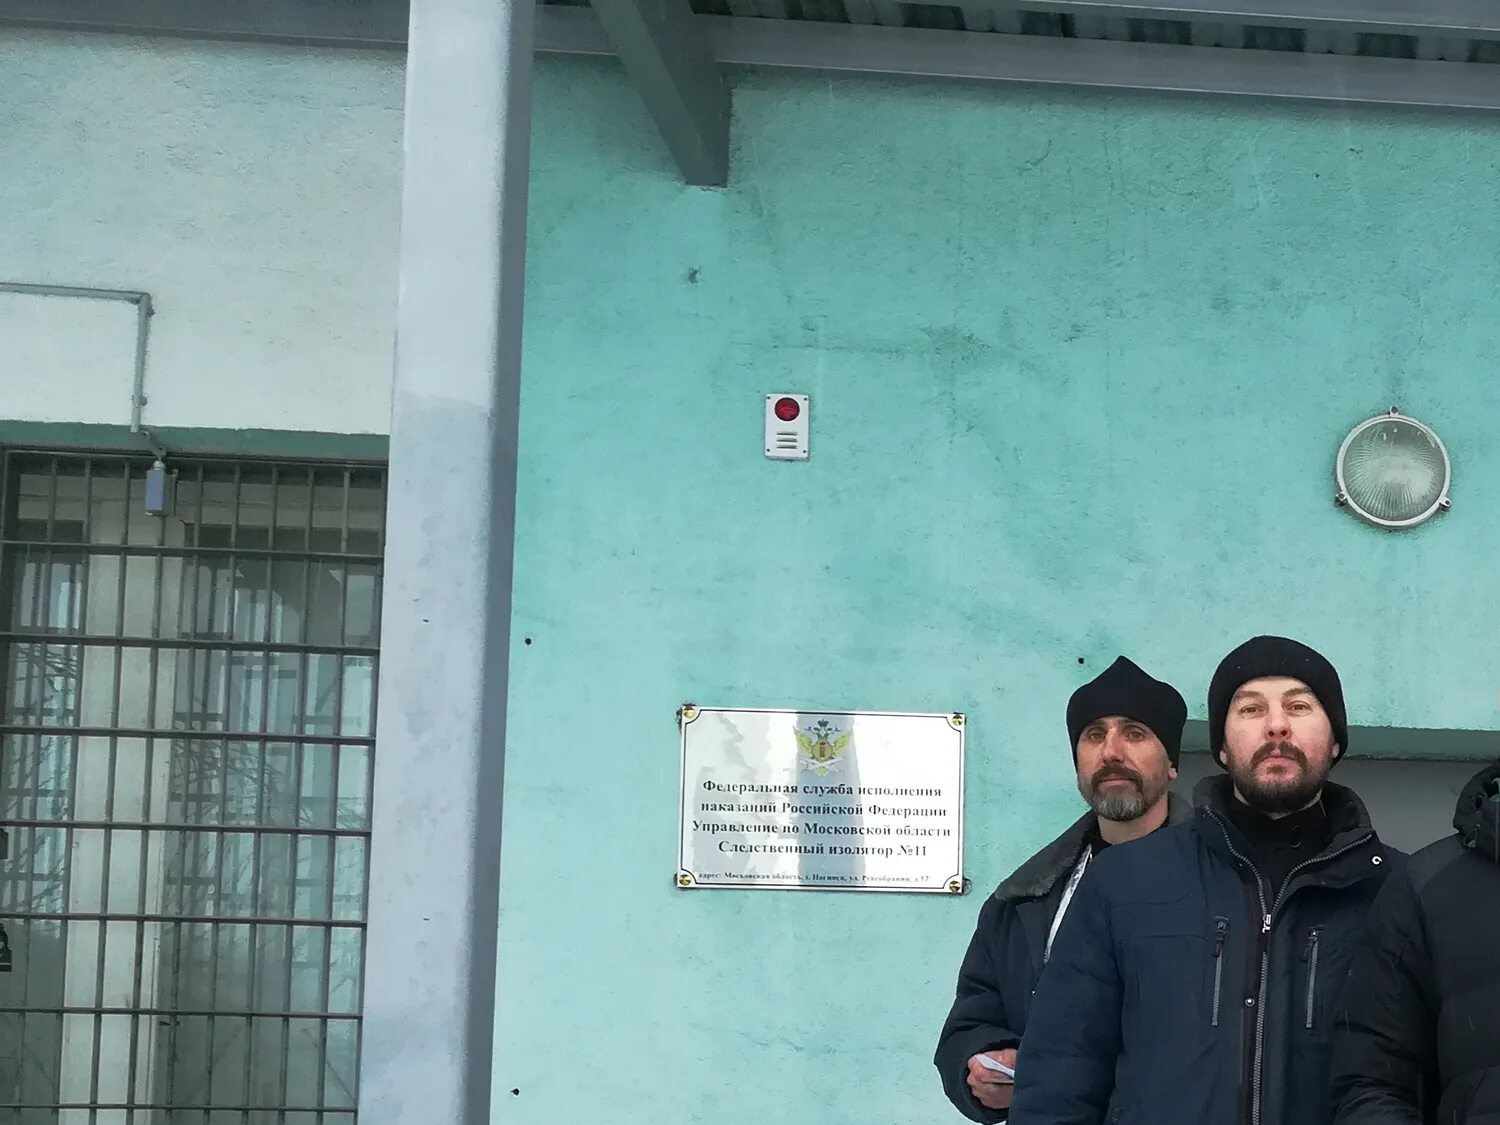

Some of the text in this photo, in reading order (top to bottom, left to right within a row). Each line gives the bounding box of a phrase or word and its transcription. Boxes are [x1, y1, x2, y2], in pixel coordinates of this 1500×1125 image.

[703, 780, 942, 797] Федеральная служба исполнения
[701, 801, 946, 819] наказаний Российской Федерации
[693, 820, 951, 837] Управление по Московской области
[718, 840, 926, 859] Следственный изолятор №11
